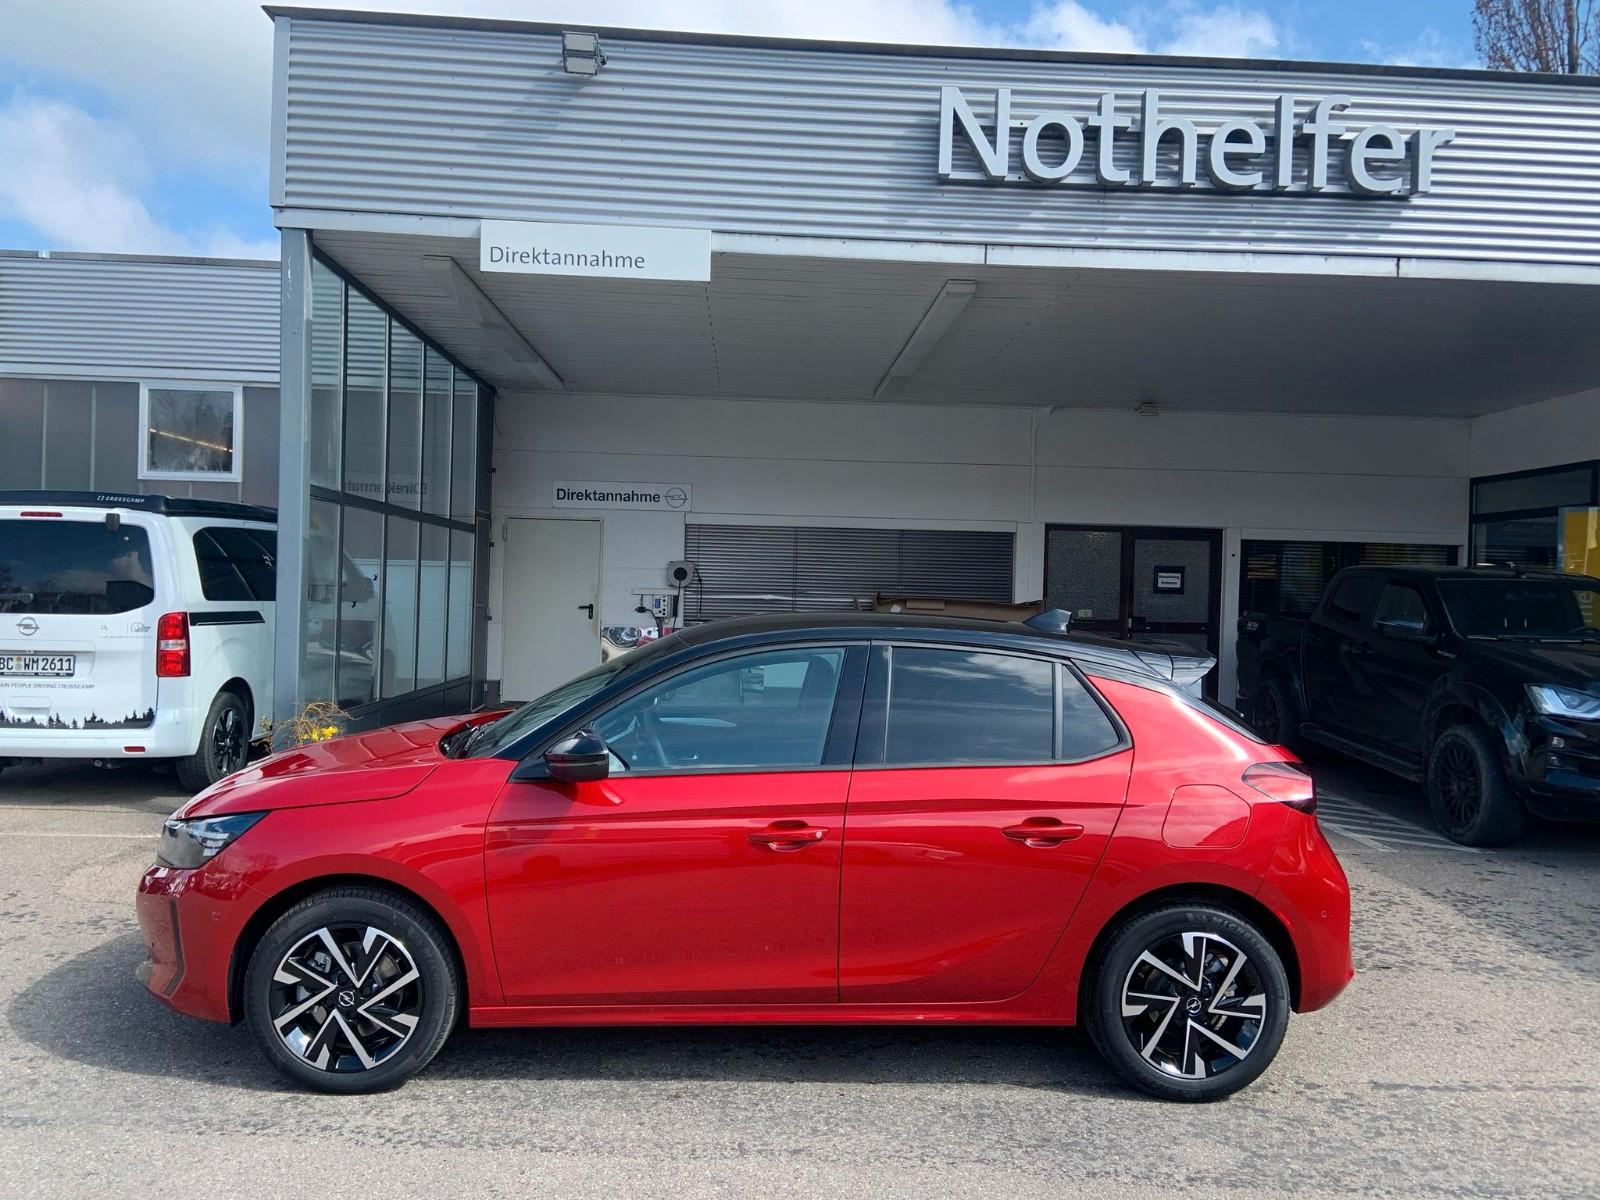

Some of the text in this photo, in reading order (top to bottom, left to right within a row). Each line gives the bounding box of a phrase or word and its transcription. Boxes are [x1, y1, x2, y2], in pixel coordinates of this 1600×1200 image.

[938, 86, 1455, 197] Nothelfer
[490, 246, 645, 269] Direktannahme
[556, 488, 661, 503] Direktannahme
[23, 657, 39, 671] WM
[41, 658, 72, 671] 2611
